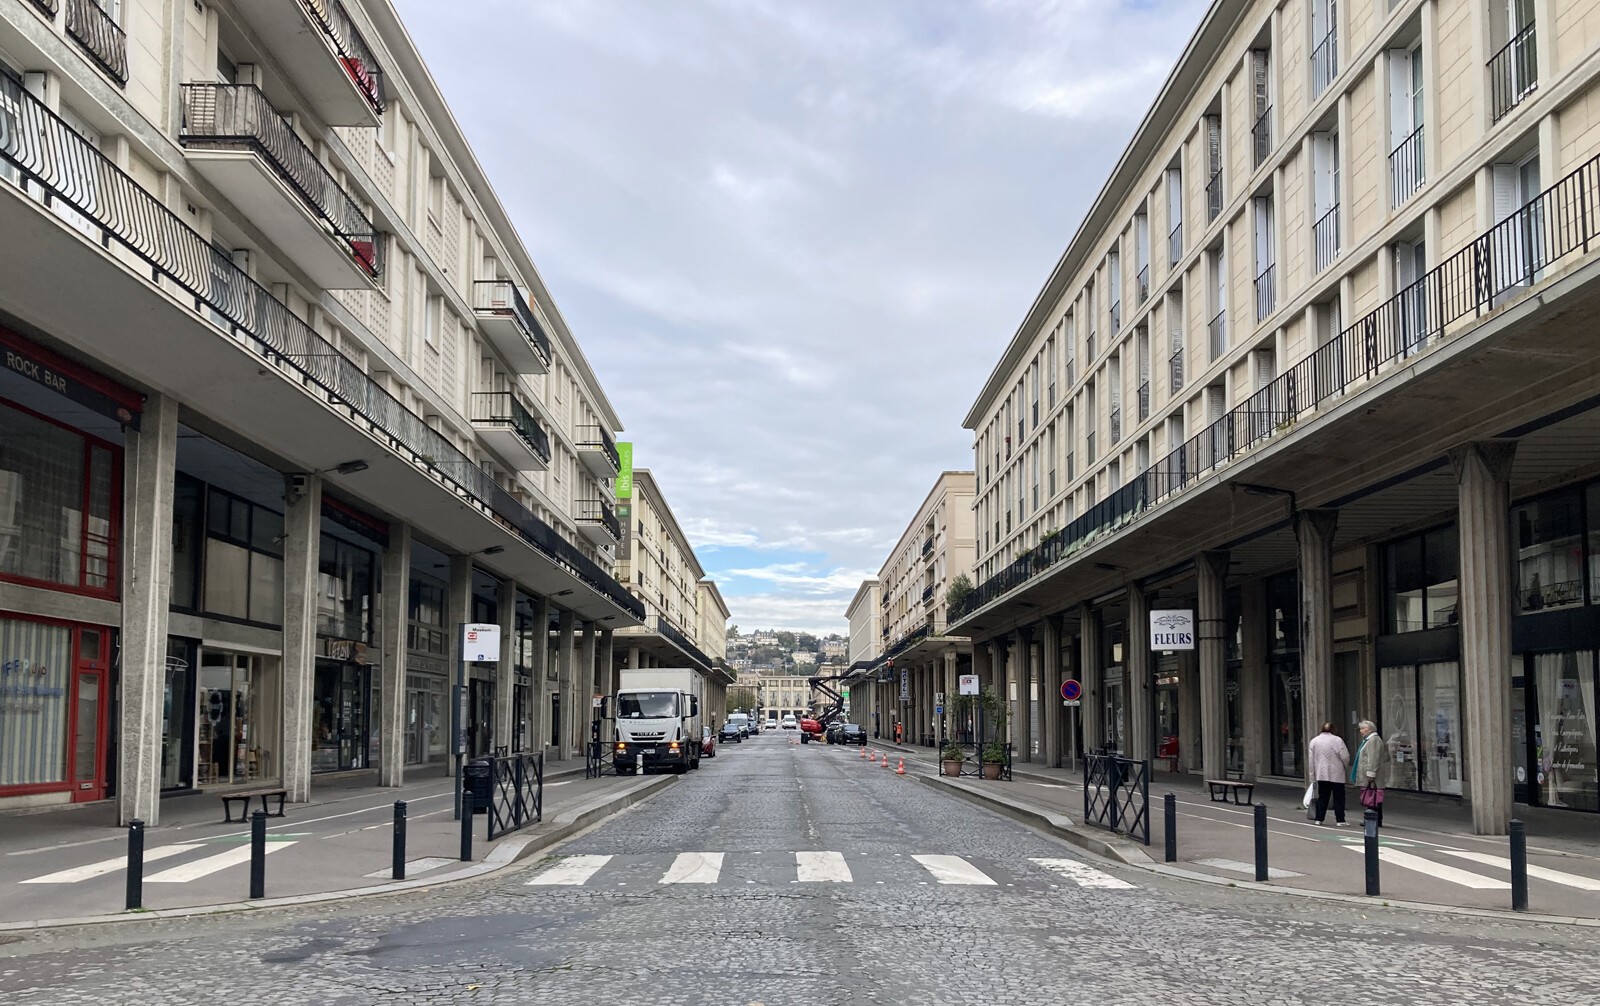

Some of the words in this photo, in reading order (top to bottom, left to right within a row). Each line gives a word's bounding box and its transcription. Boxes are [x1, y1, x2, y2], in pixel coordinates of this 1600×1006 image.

[6, 351, 40, 380] ROCK
[44, 370, 67, 393] BAR
[620, 475, 630, 491] ibis
[1154, 632, 1192, 645] FLEURS
